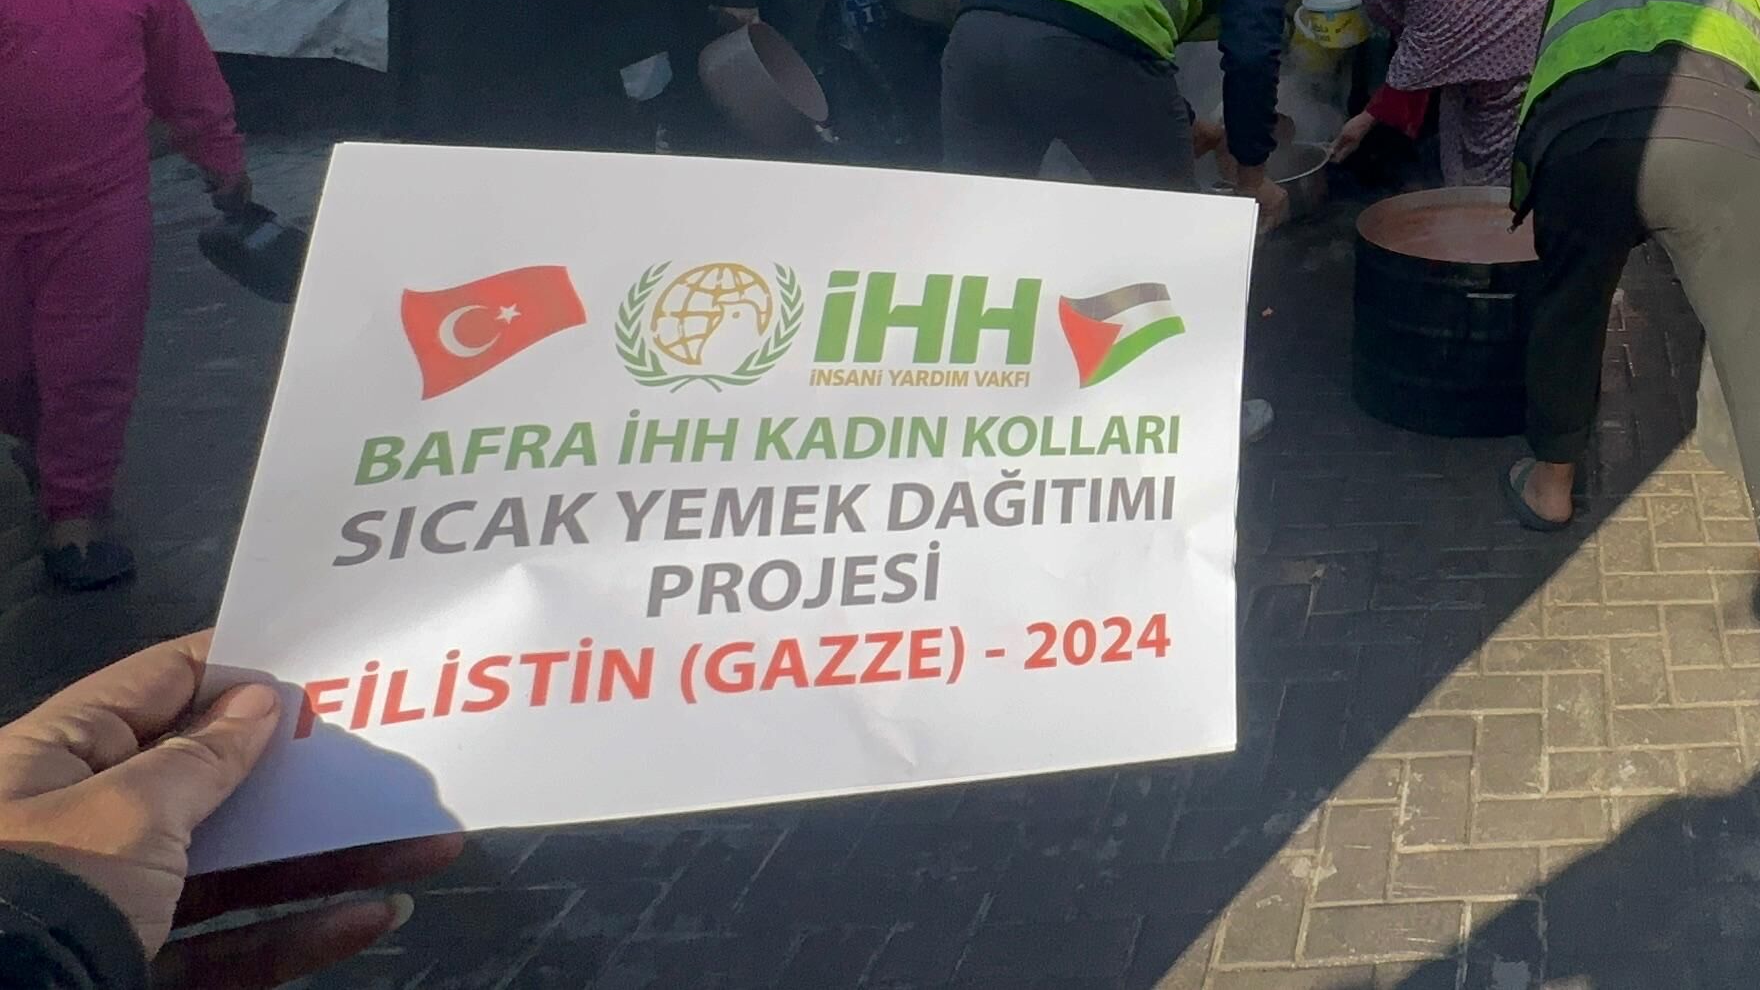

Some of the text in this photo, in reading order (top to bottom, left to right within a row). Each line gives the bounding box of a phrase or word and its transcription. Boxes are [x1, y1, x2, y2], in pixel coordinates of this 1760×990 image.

[888, 369, 969, 387] YARDIM
[974, 370, 1031, 388] VAKFI
[353, 408, 1181, 486] BAFRA İHH KADIN KOLLARI
[331, 468, 1176, 568] SICAK YEMEK DAĞITIMI
[645, 539, 941, 619] PROJESİ
[293, 636, 654, 740] FİLİSTİN
[679, 625, 966, 705] (GAZZE)
[1023, 612, 1172, 671] 2024
